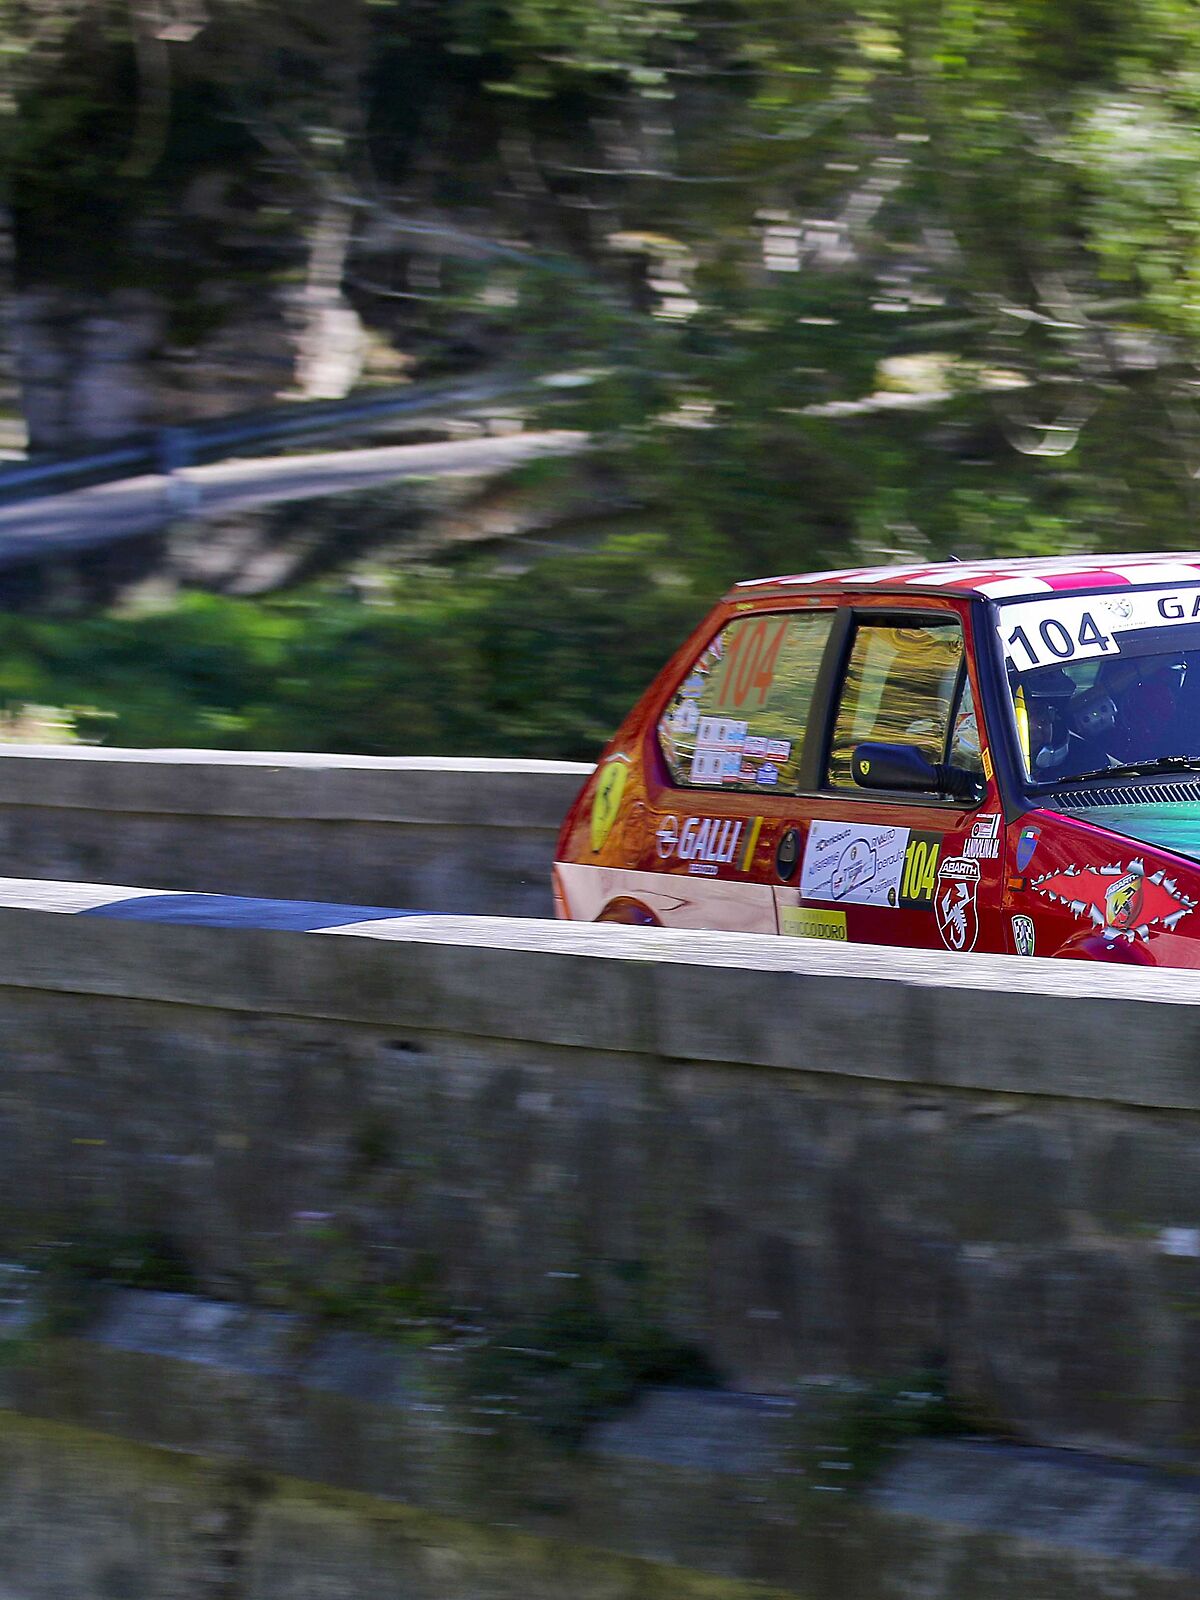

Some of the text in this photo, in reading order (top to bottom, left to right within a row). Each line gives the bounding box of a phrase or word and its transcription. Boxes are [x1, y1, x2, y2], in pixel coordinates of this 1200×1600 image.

[718, 618, 790, 708] 104
[1008, 611, 1110, 664] 104
[677, 817, 743, 863] GALLI
[902, 840, 940, 900] 104
[942, 862, 978, 876] ABARTH
